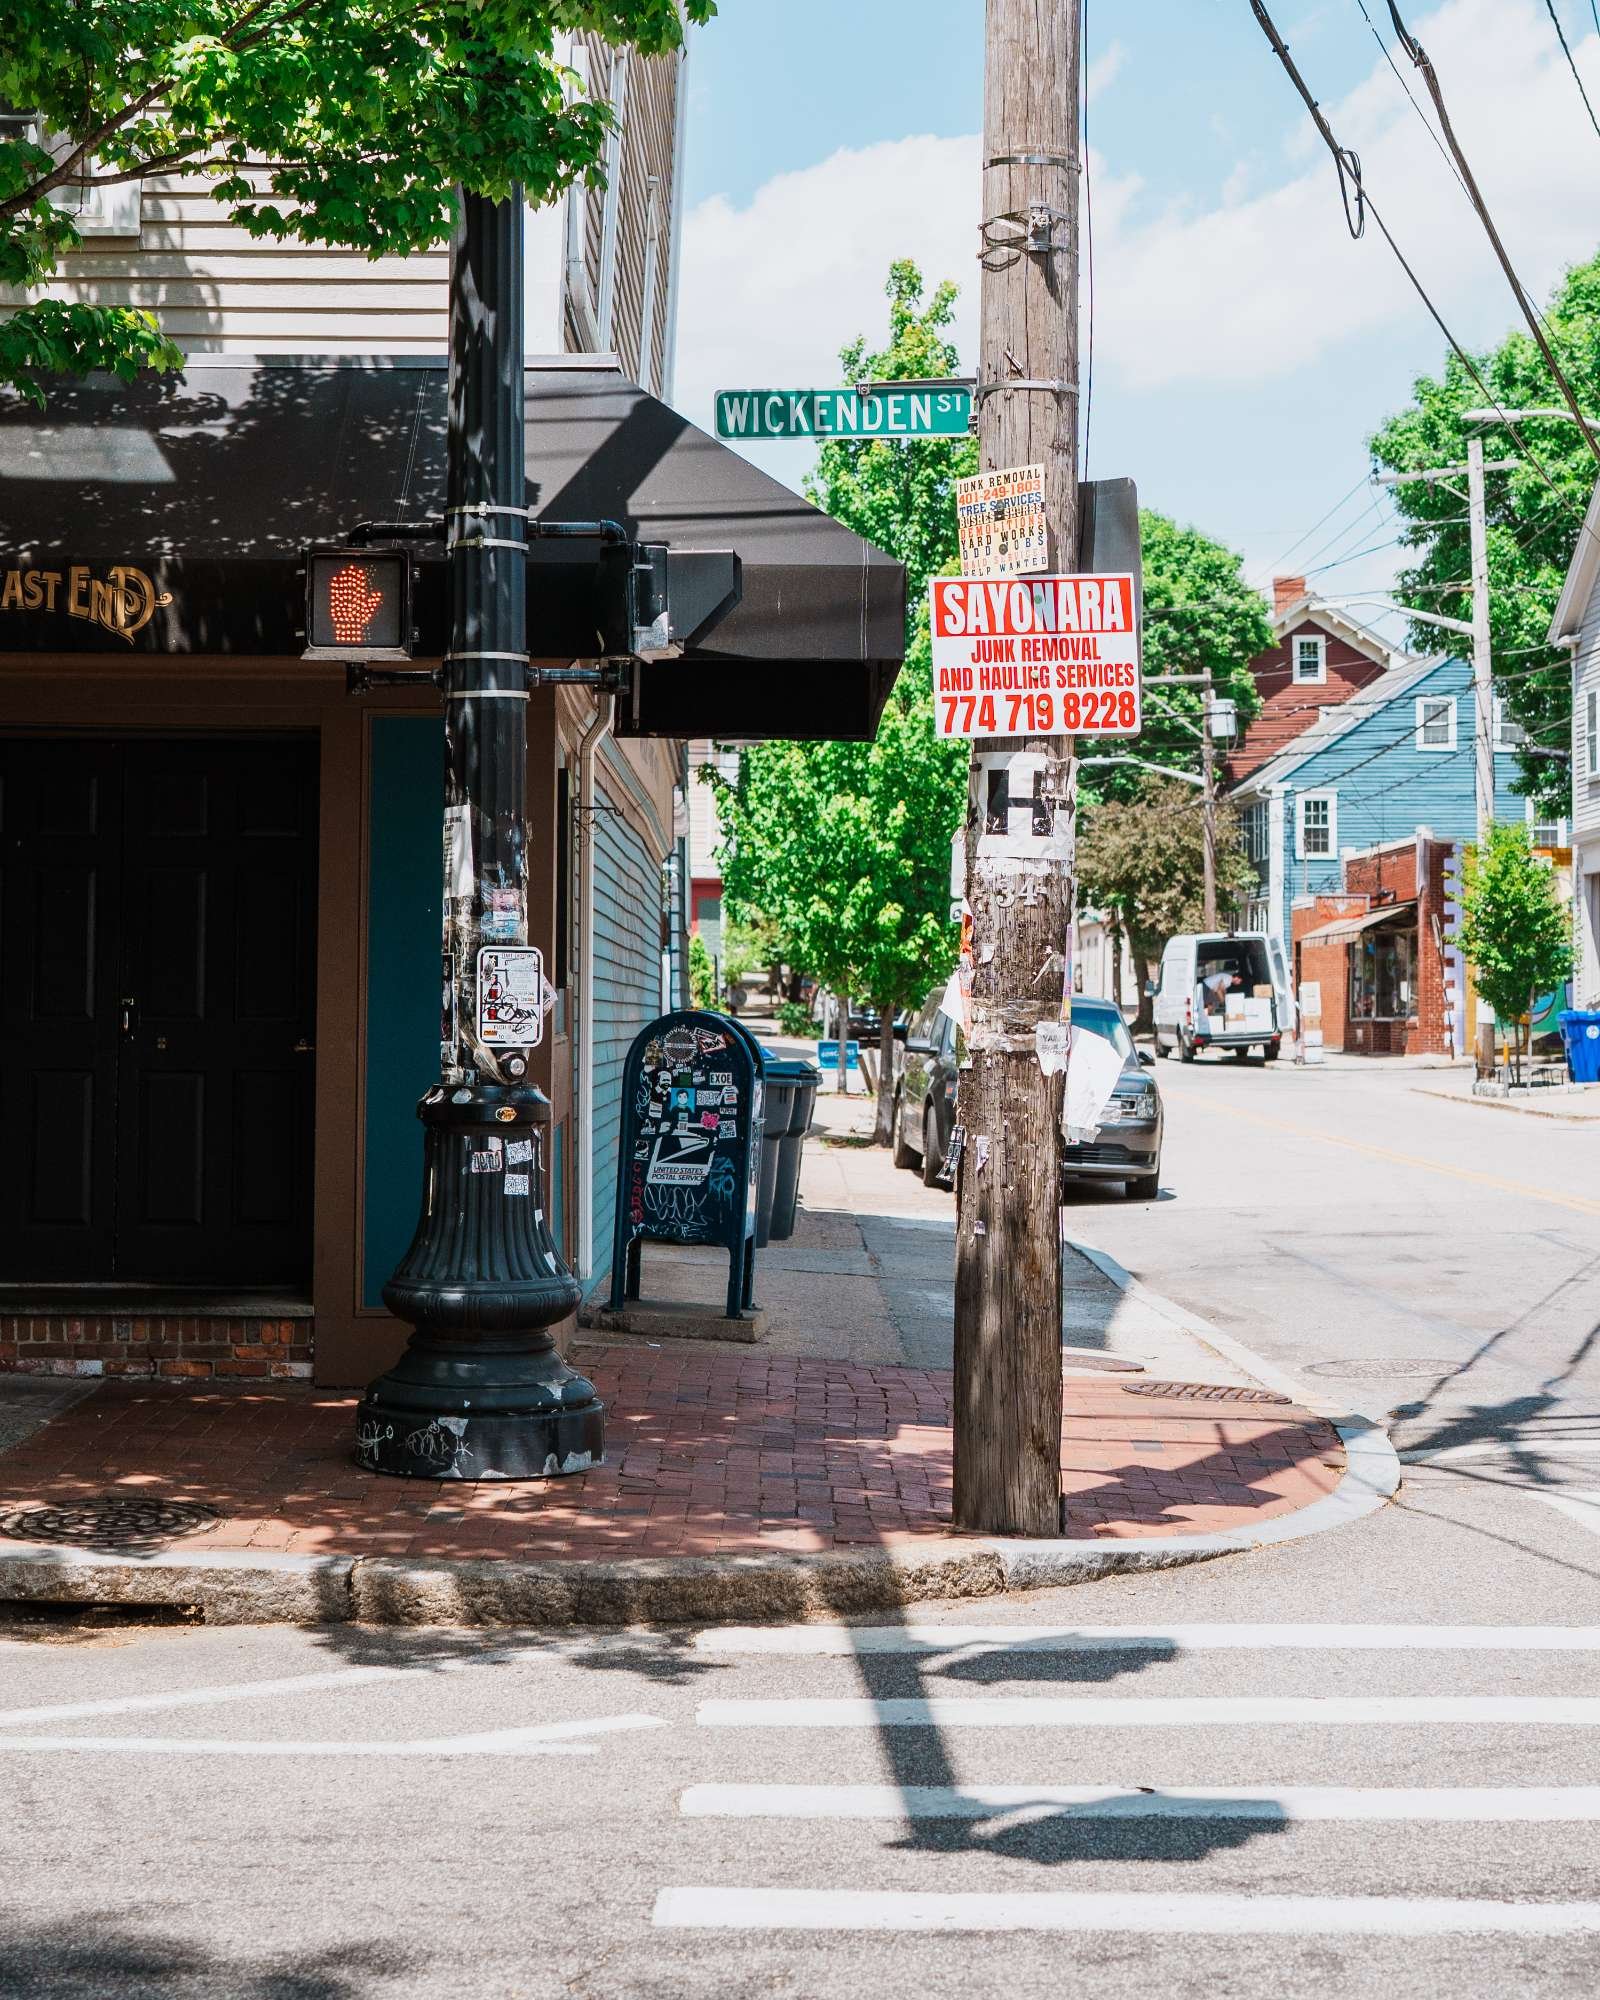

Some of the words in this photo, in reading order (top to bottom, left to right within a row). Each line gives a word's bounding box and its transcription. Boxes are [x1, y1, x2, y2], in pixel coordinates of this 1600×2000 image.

[723, 393, 932, 433] WICKENDEN
[936, 393, 965, 413] ST
[988, 468, 1041, 488] REMOVAL
[959, 480, 1041, 506] 401-249-1803
[959, 502, 987, 517] TREE
[990, 491, 1042, 511] SRVICES
[960, 514, 1044, 540] DEMOLITIONS
[961, 534, 992, 550] YARD
[1000, 524, 1044, 543] WORKS
[963, 545, 991, 560] ODD
[999, 556, 1047, 573] WANTED
[0, 569, 62, 612] AST
[942, 580, 1125, 635] SAYONARA
[970, 638, 1017, 664] JUNK
[1021, 637, 1102, 662] REMOVAL
[939, 667, 974, 691] AND
[978, 665, 1051, 691] HAULING
[1055, 663, 1135, 689] SERVICES
[941, 694, 998, 733] 774
[1004, 693, 1055, 732] 719
[1063, 690, 1136, 731] 8228
[710, 1073, 732, 1085] EXOE
[678, 1174, 705, 1182] SERVICE
[679, 1167, 704, 1175] STATES
